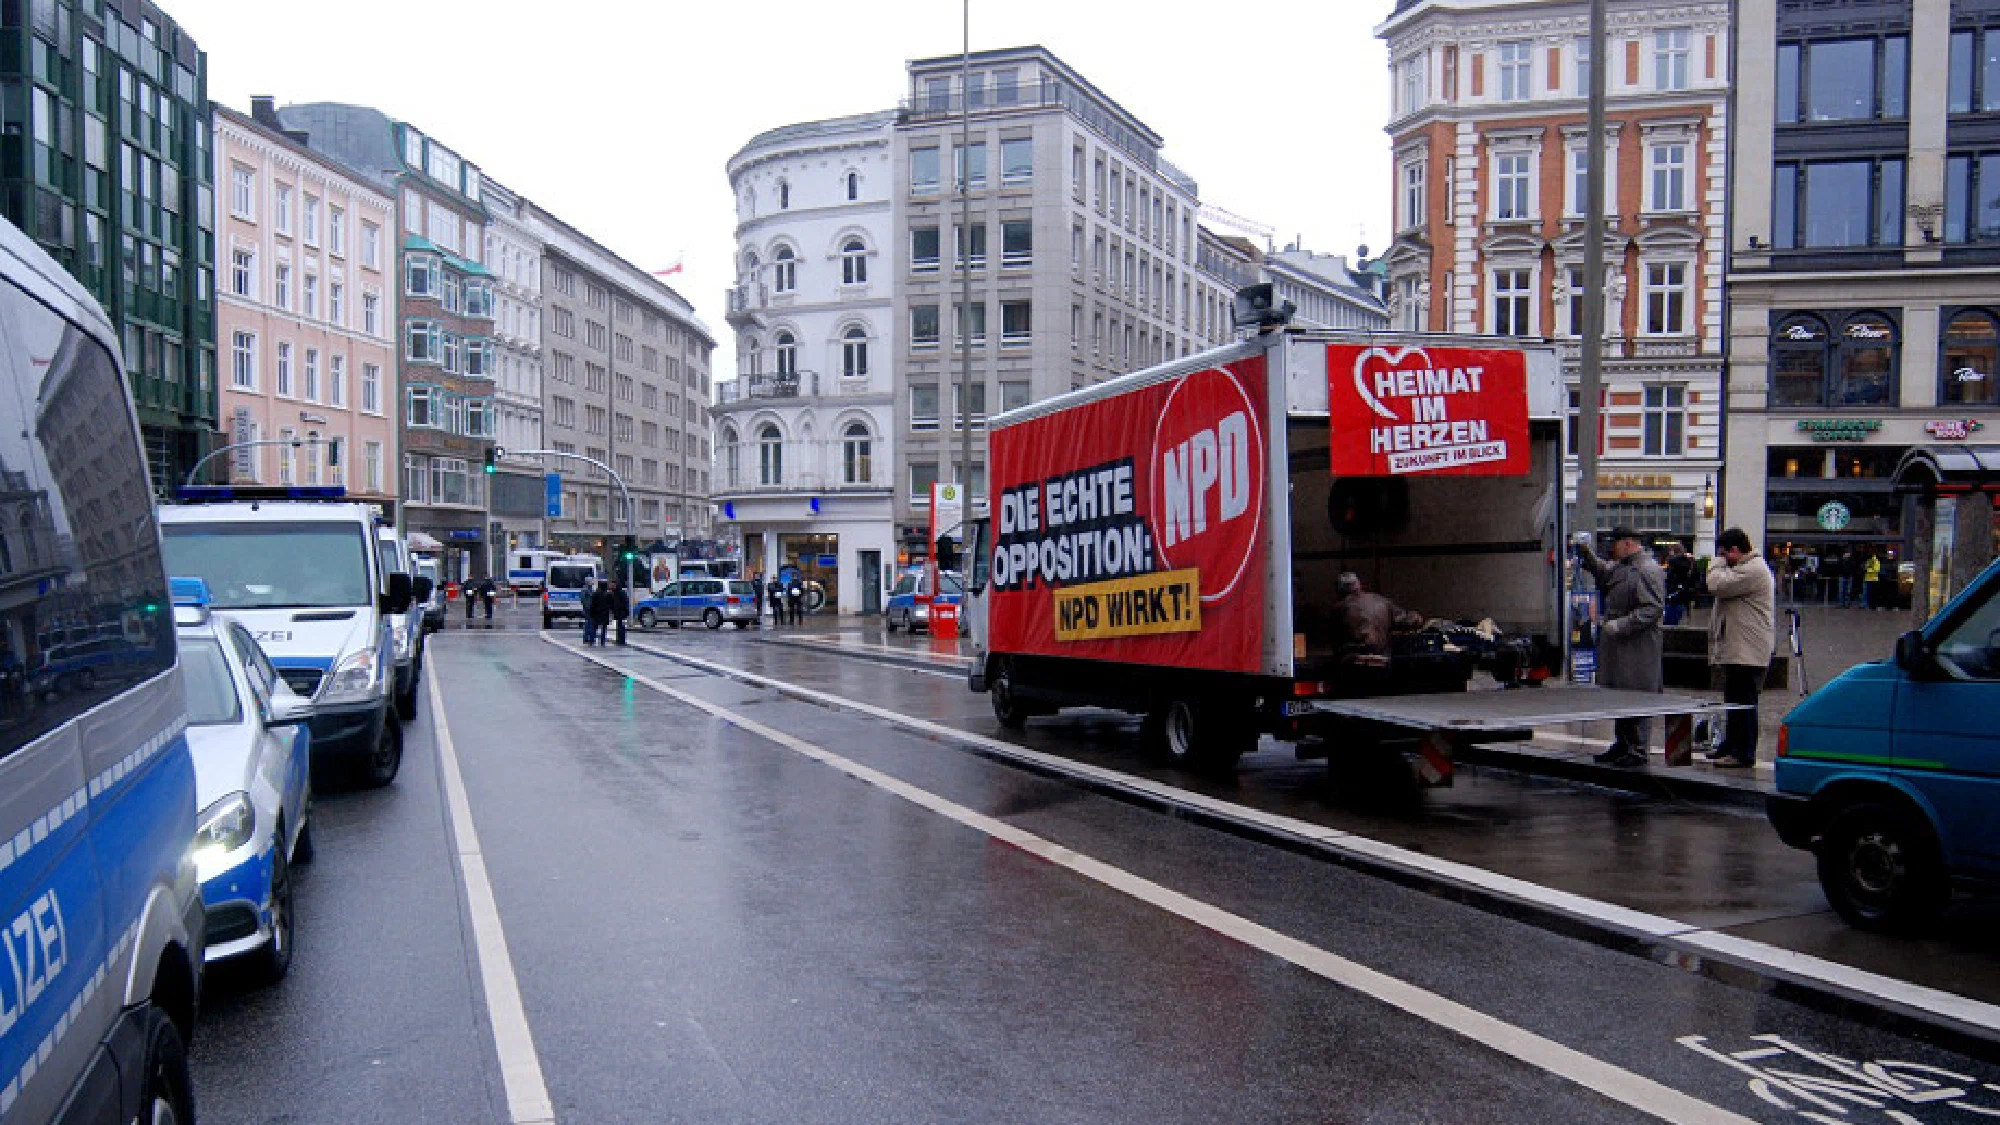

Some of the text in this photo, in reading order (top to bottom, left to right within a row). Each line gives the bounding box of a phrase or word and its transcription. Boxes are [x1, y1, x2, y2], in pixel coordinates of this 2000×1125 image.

[1374, 366, 1484, 397] HEIMAT
[1412, 395, 1447, 422] IM
[1370, 420, 1487, 454] HERZEN
[1394, 443, 1502, 469] ZUKUNFT IM BLICK
[1000, 465, 1133, 534] DIE ECHTE
[1163, 410, 1250, 549] NPD
[993, 523, 1153, 586] OPPOSITION:
[1059, 582, 1192, 632] NPD WIRKT!
